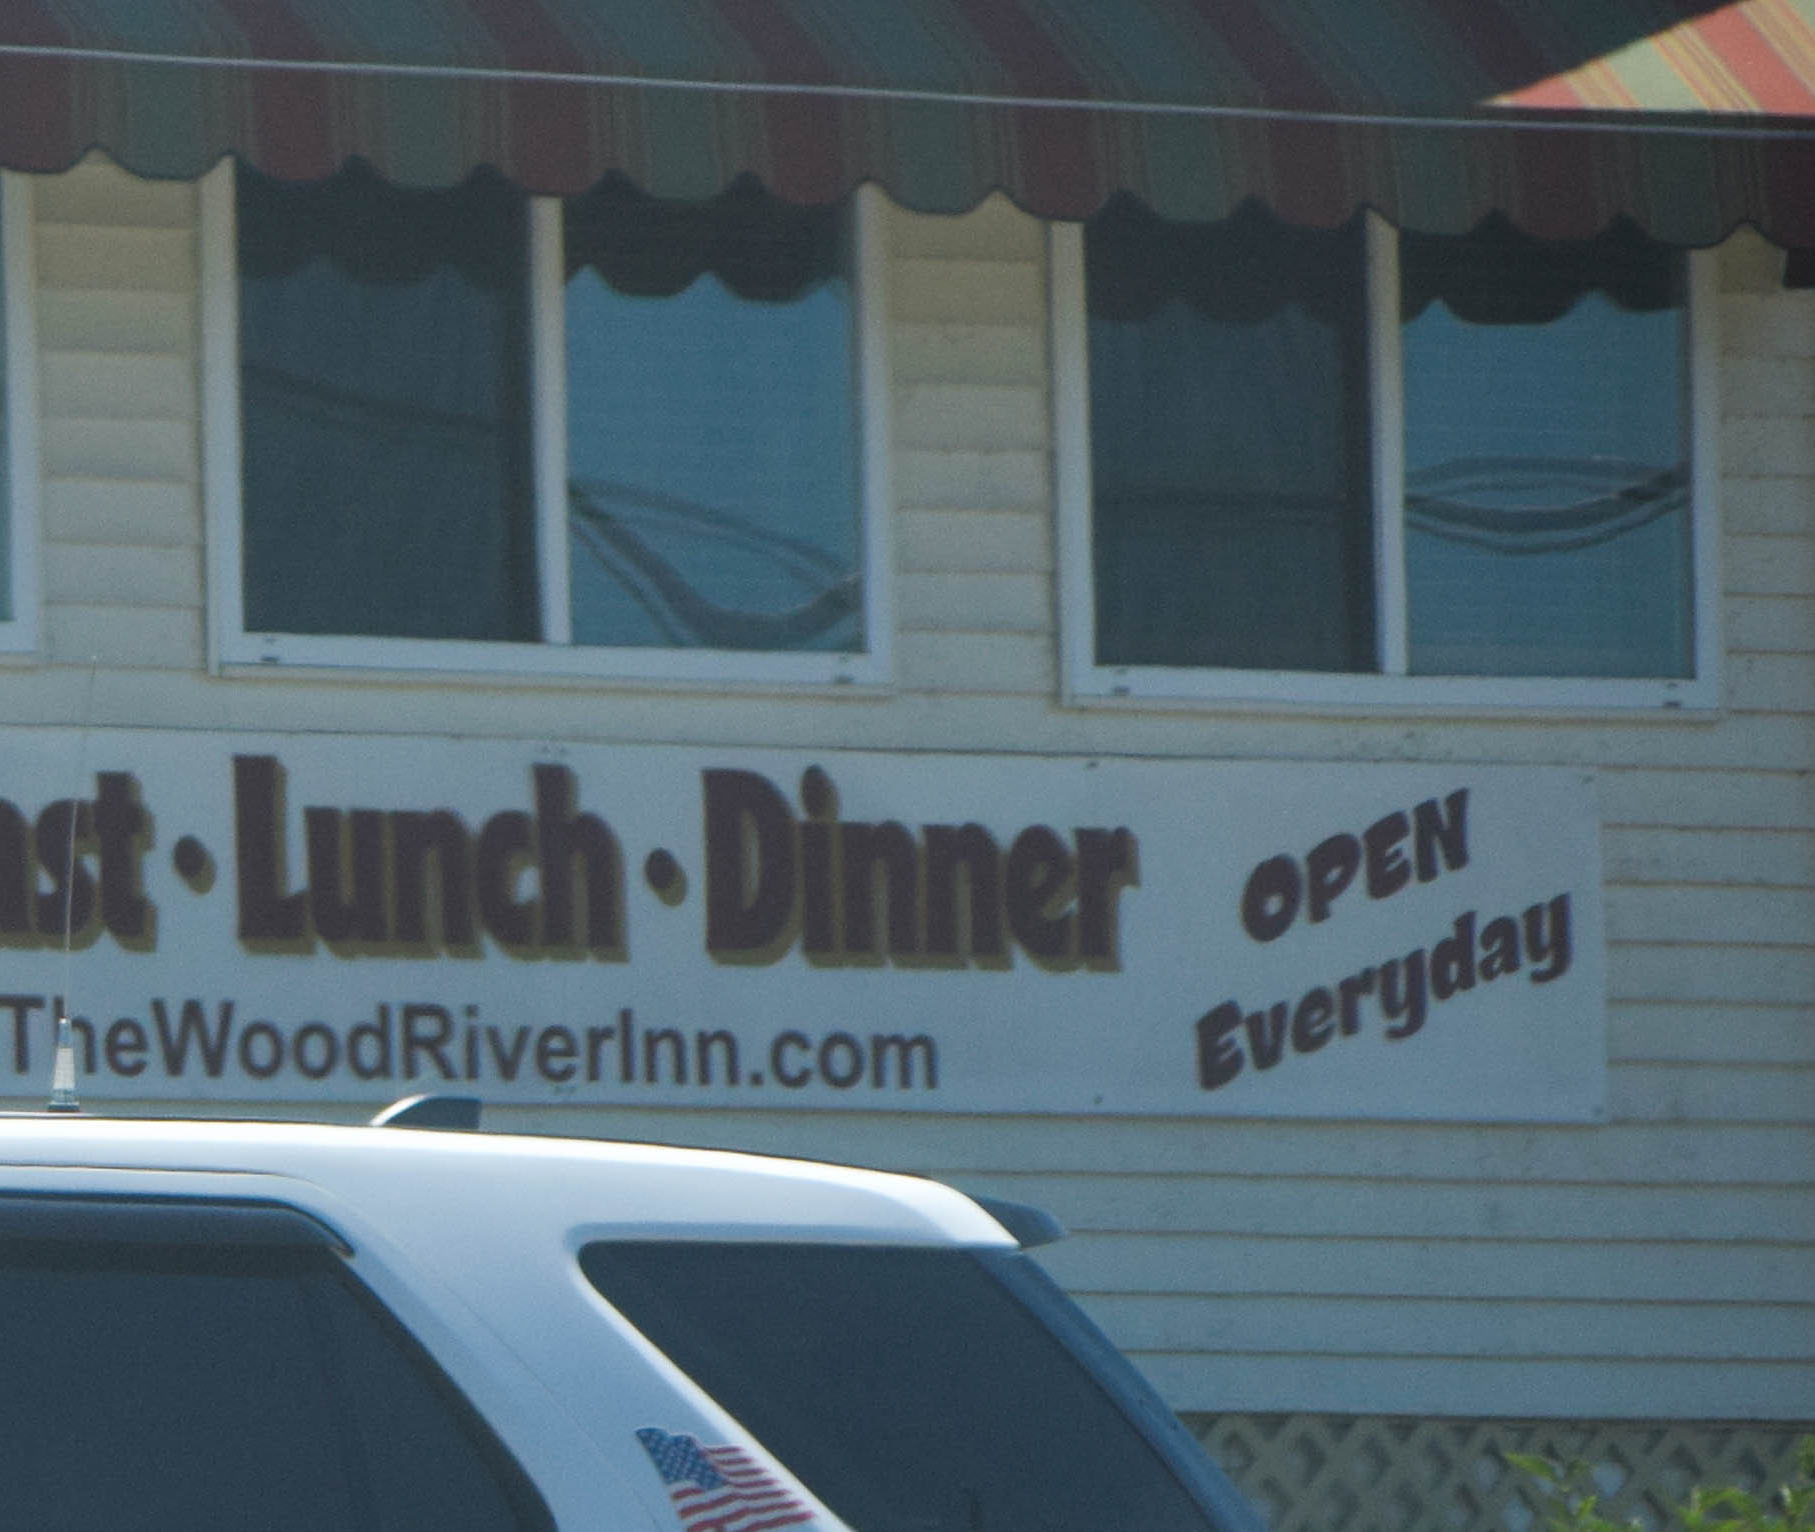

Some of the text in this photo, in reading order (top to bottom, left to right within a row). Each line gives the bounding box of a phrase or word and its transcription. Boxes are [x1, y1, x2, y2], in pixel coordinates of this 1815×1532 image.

[231, 752, 629, 964] Lunch
[700, 765, 1142, 973] Dinner
[1239, 787, 1473, 943] OPEN
[1195, 891, 1572, 1091] Everyday
